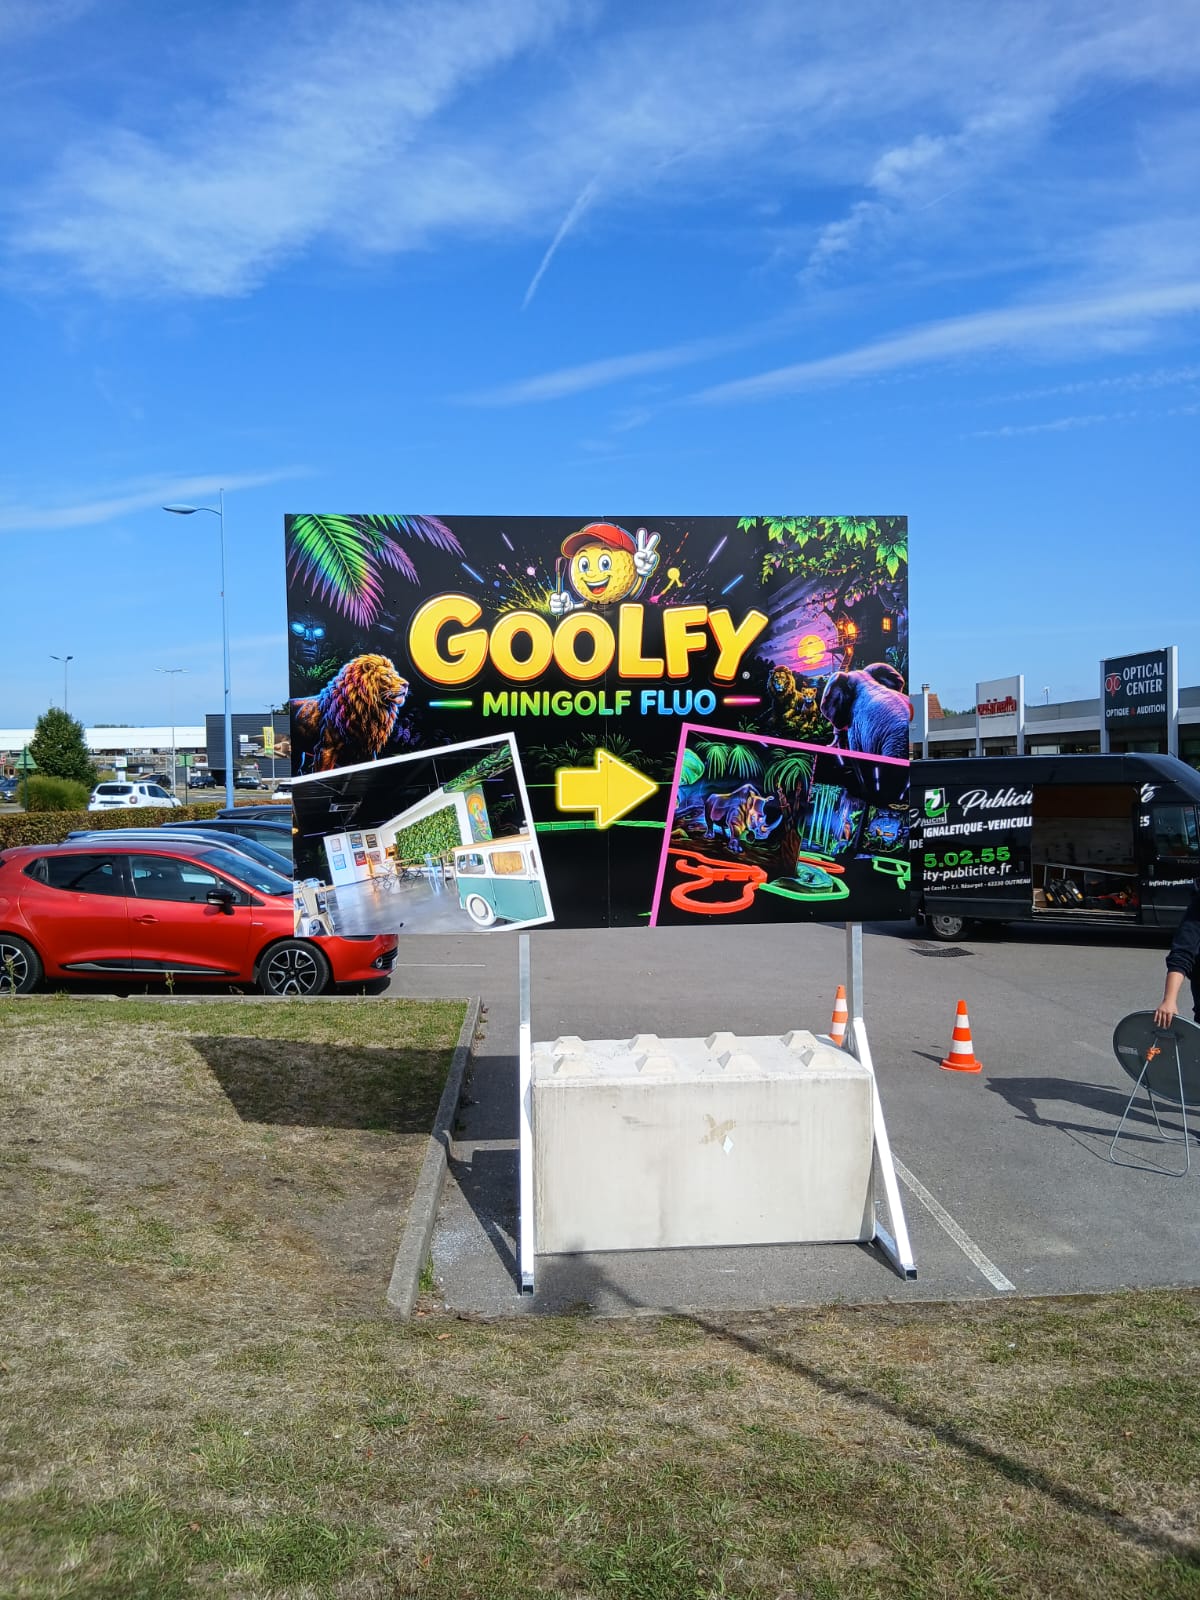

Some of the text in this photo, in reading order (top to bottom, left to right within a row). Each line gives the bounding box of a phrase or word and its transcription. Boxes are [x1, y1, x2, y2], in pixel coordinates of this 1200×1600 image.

[409, 594, 768, 684] GOOLFY
[1123, 662, 1165, 680] OPTICAL
[1126, 679, 1163, 696] CENTER
[483, 689, 716, 716] MINIGOLF FLUO
[1106, 707, 1130, 718] OPTIQUE
[1136, 704, 1166, 715] AUDITION
[924, 846, 1011, 868] 5.02.55
[923, 863, 1012, 882] ity-publicite.fr
